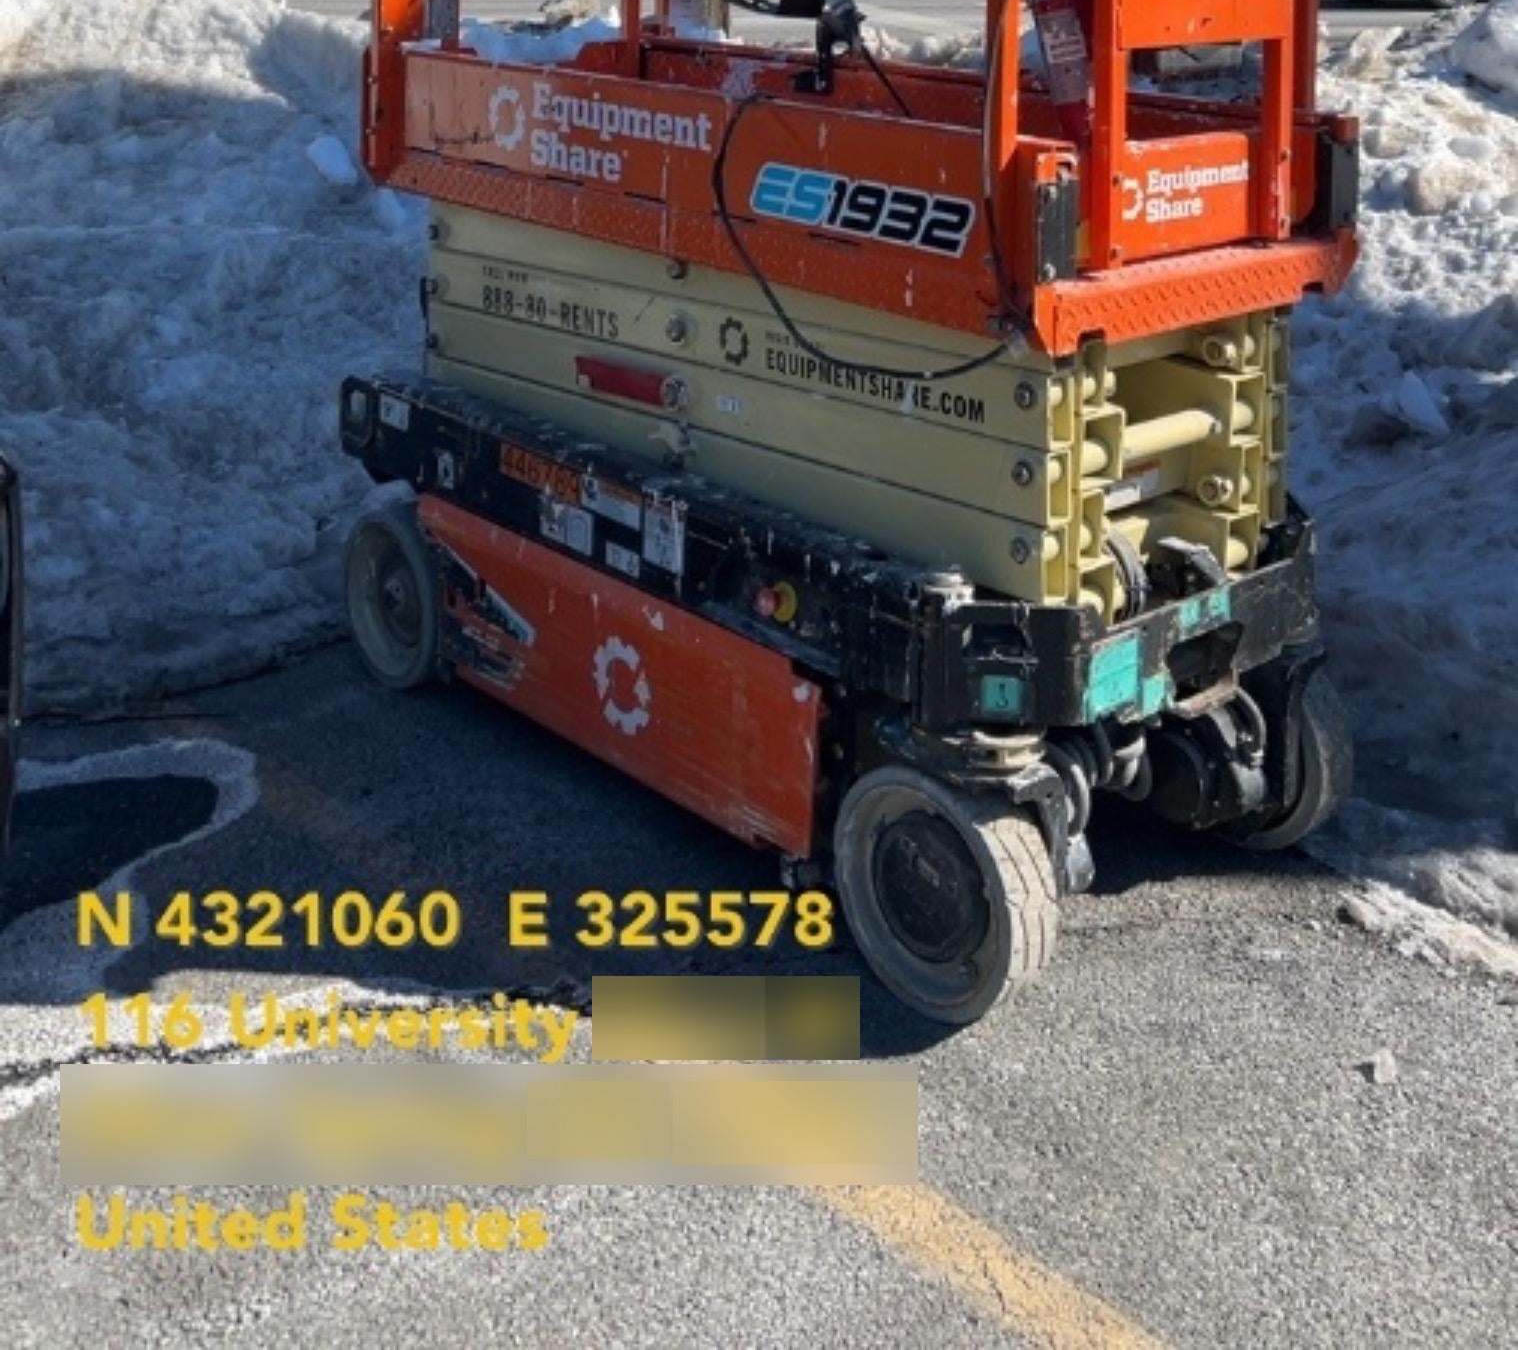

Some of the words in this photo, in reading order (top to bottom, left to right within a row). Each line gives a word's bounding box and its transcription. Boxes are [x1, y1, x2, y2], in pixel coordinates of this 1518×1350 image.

[531, 82, 713, 152] Equipment
[529, 128, 622, 182] Share
[1145, 160, 1249, 196] Equipment
[750, 162, 976, 258] ES1932
[1144, 195, 1204, 224] Share
